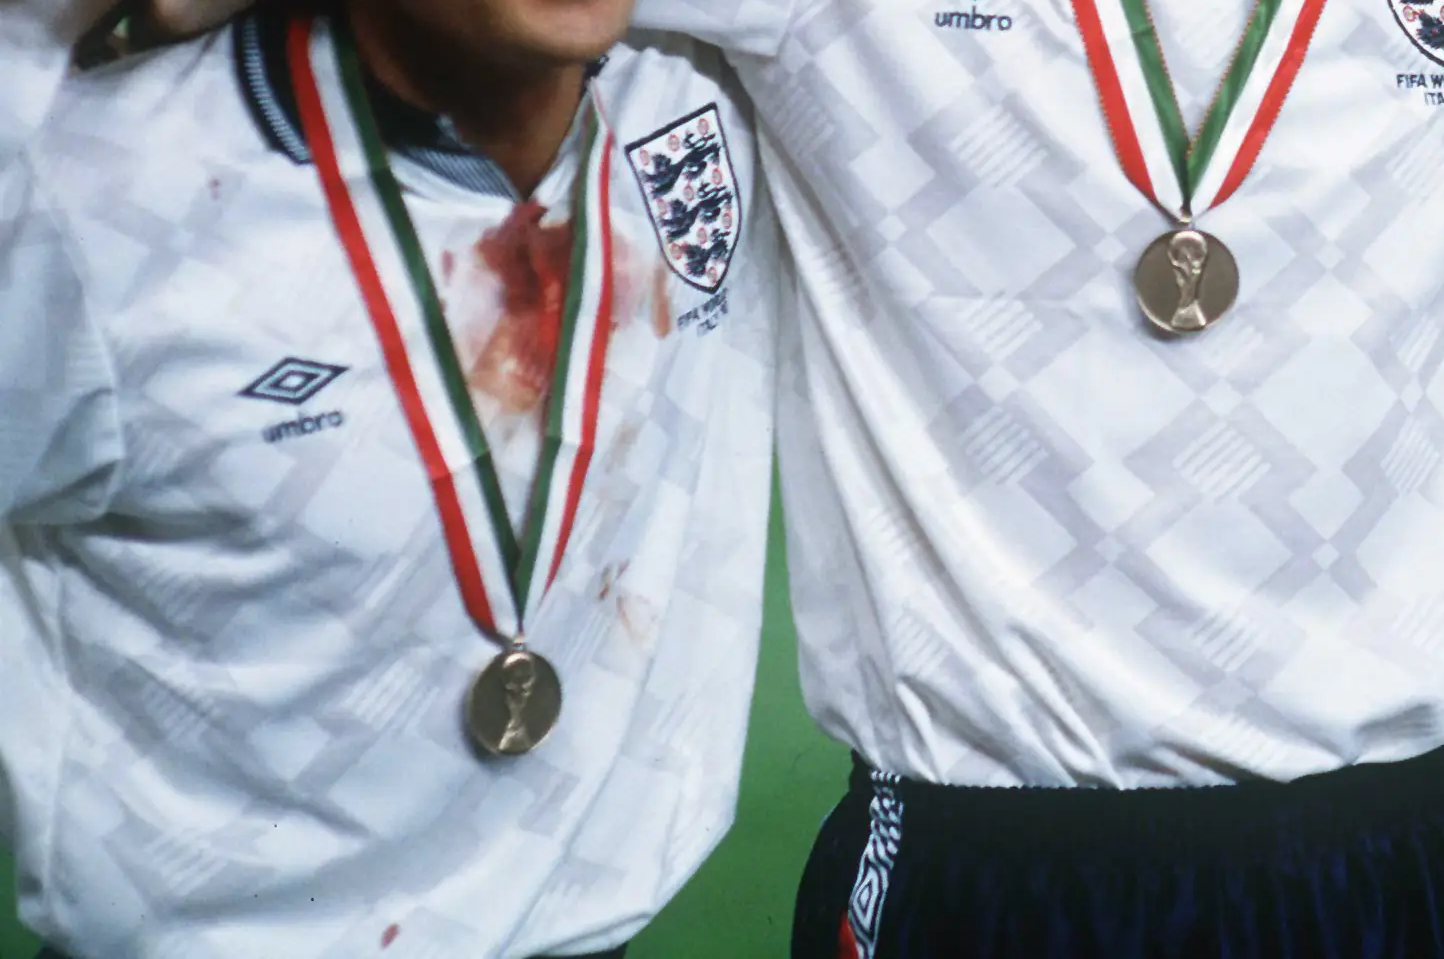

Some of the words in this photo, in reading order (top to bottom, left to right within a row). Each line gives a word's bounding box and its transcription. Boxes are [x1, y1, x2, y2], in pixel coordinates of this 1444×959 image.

[935, 5, 1012, 31] umbro
[1396, 73, 1427, 88] FIFA
[262, 410, 343, 443] umbro
